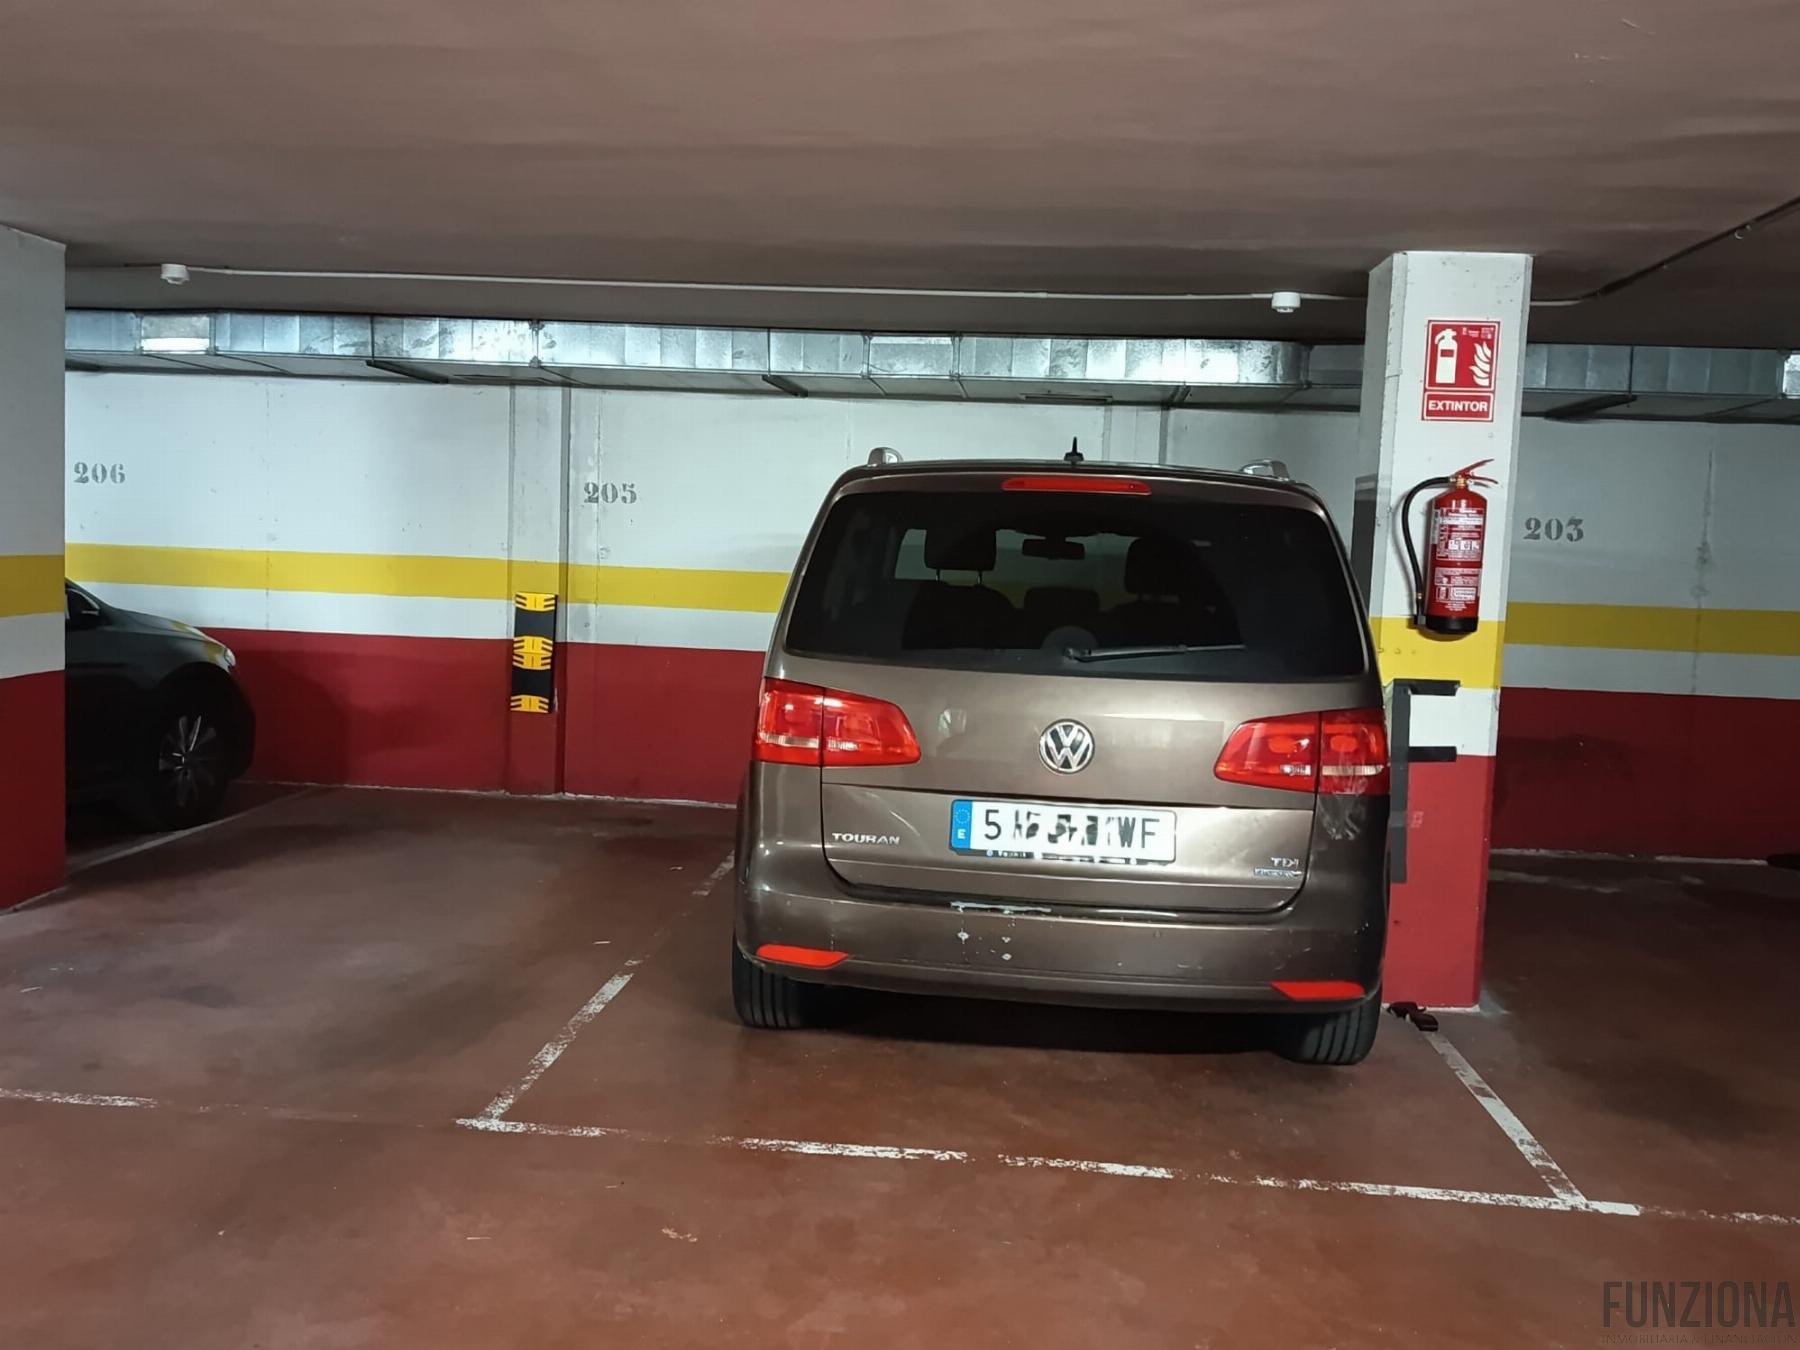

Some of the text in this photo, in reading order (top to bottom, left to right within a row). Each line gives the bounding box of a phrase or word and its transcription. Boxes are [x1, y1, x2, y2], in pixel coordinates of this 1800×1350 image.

[1428, 400, 1488, 412] EXTINTOR
[73, 462, 126, 484] 206
[583, 481, 637, 504] 205
[1523, 517, 1584, 542] 203
[832, 832, 900, 845] TOURAN
